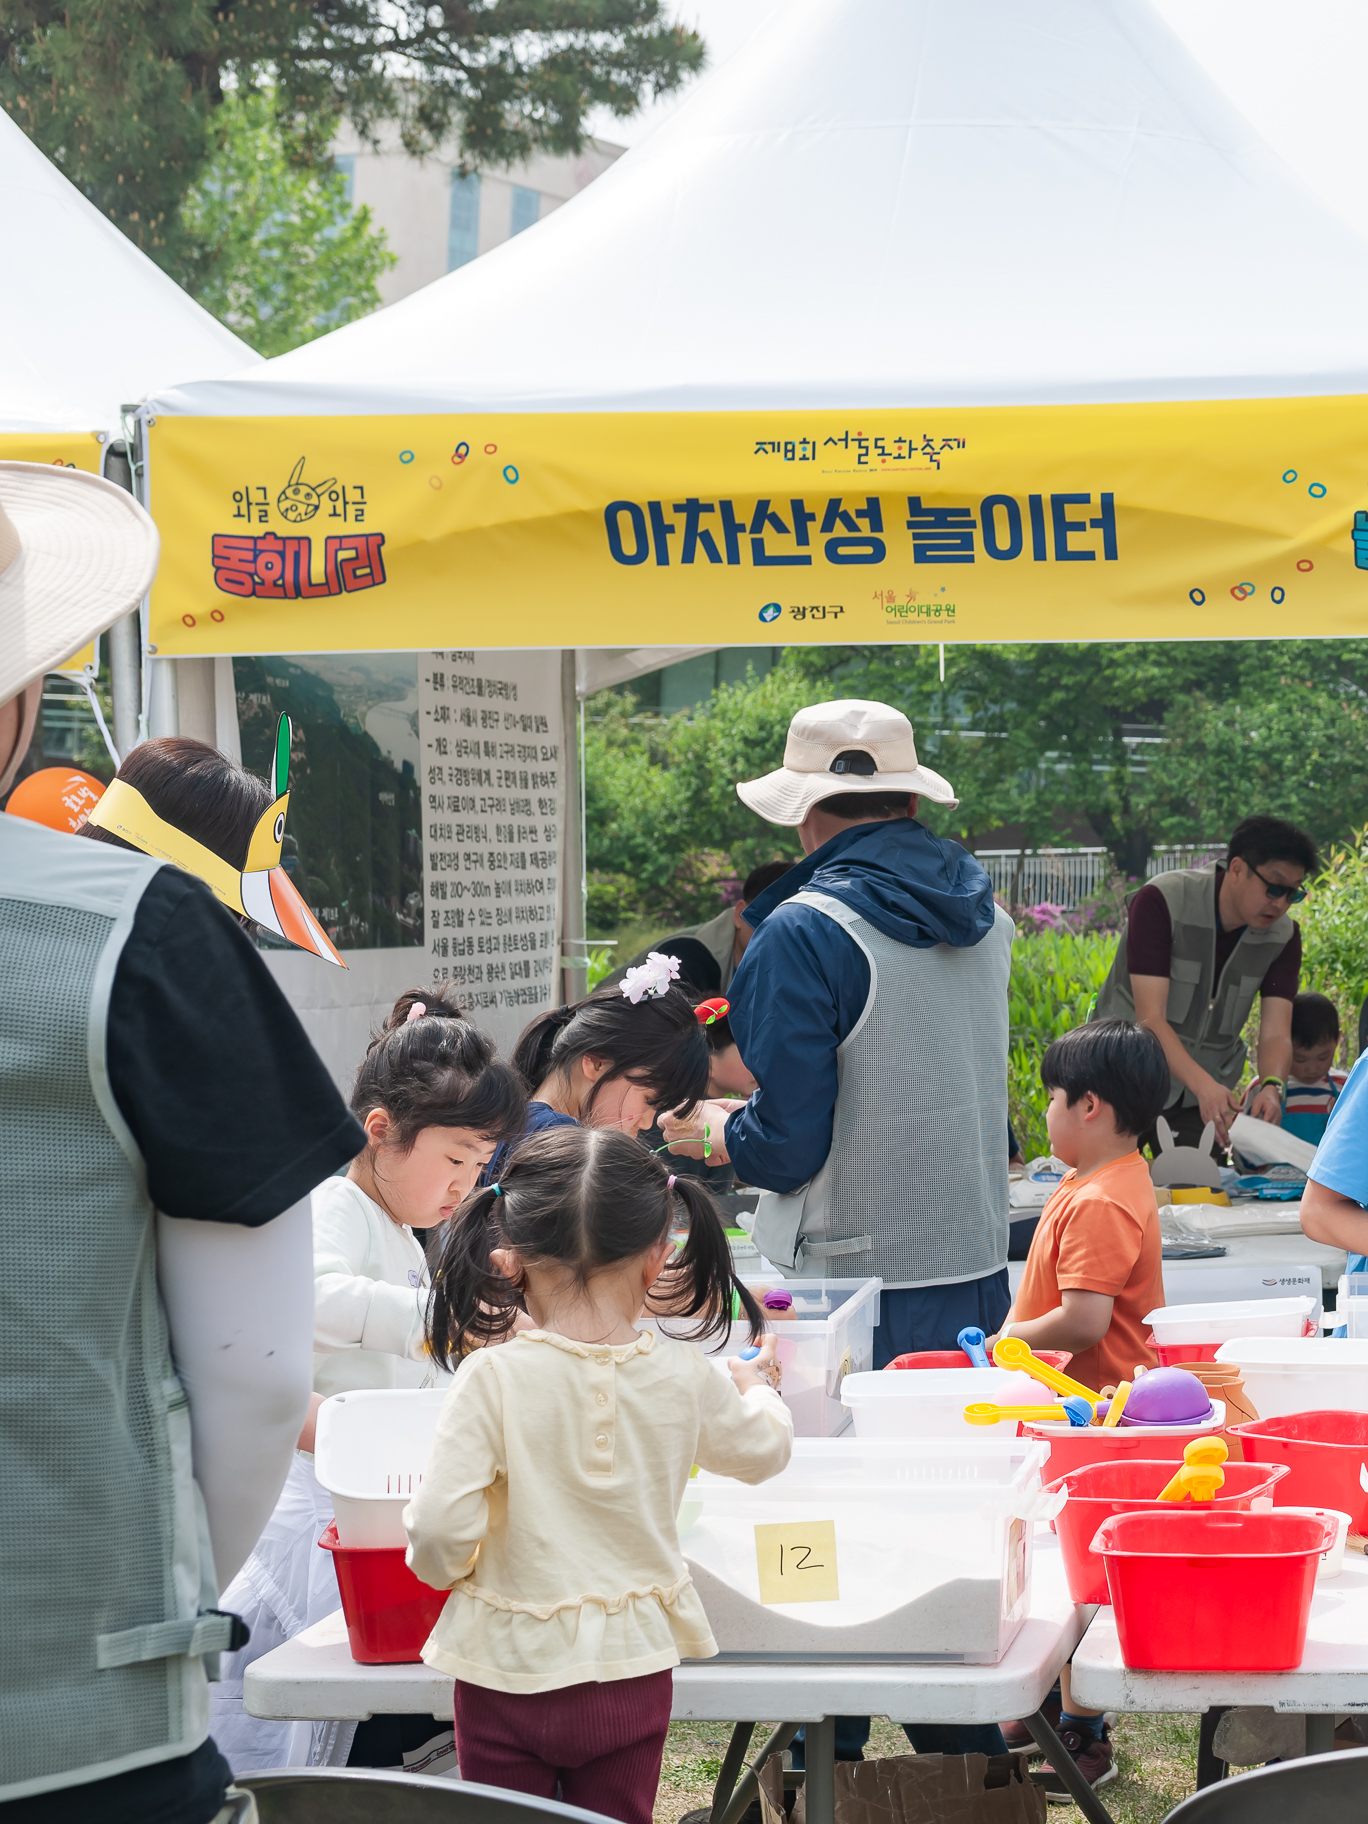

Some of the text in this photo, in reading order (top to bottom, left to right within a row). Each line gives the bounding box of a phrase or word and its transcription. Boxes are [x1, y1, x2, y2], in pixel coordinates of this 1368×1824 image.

[754, 430, 966, 470] 제8회 서울동화축제
[232, 485, 367, 523] 와글 와글
[603, 492, 1119, 567] 아차산성 놀이터
[212, 531, 387, 600] 동화나라
[788, 605, 845, 621] 광진구
[885, 603, 956, 617] 어린이대공원
[780, 1544, 825, 1576] 12
